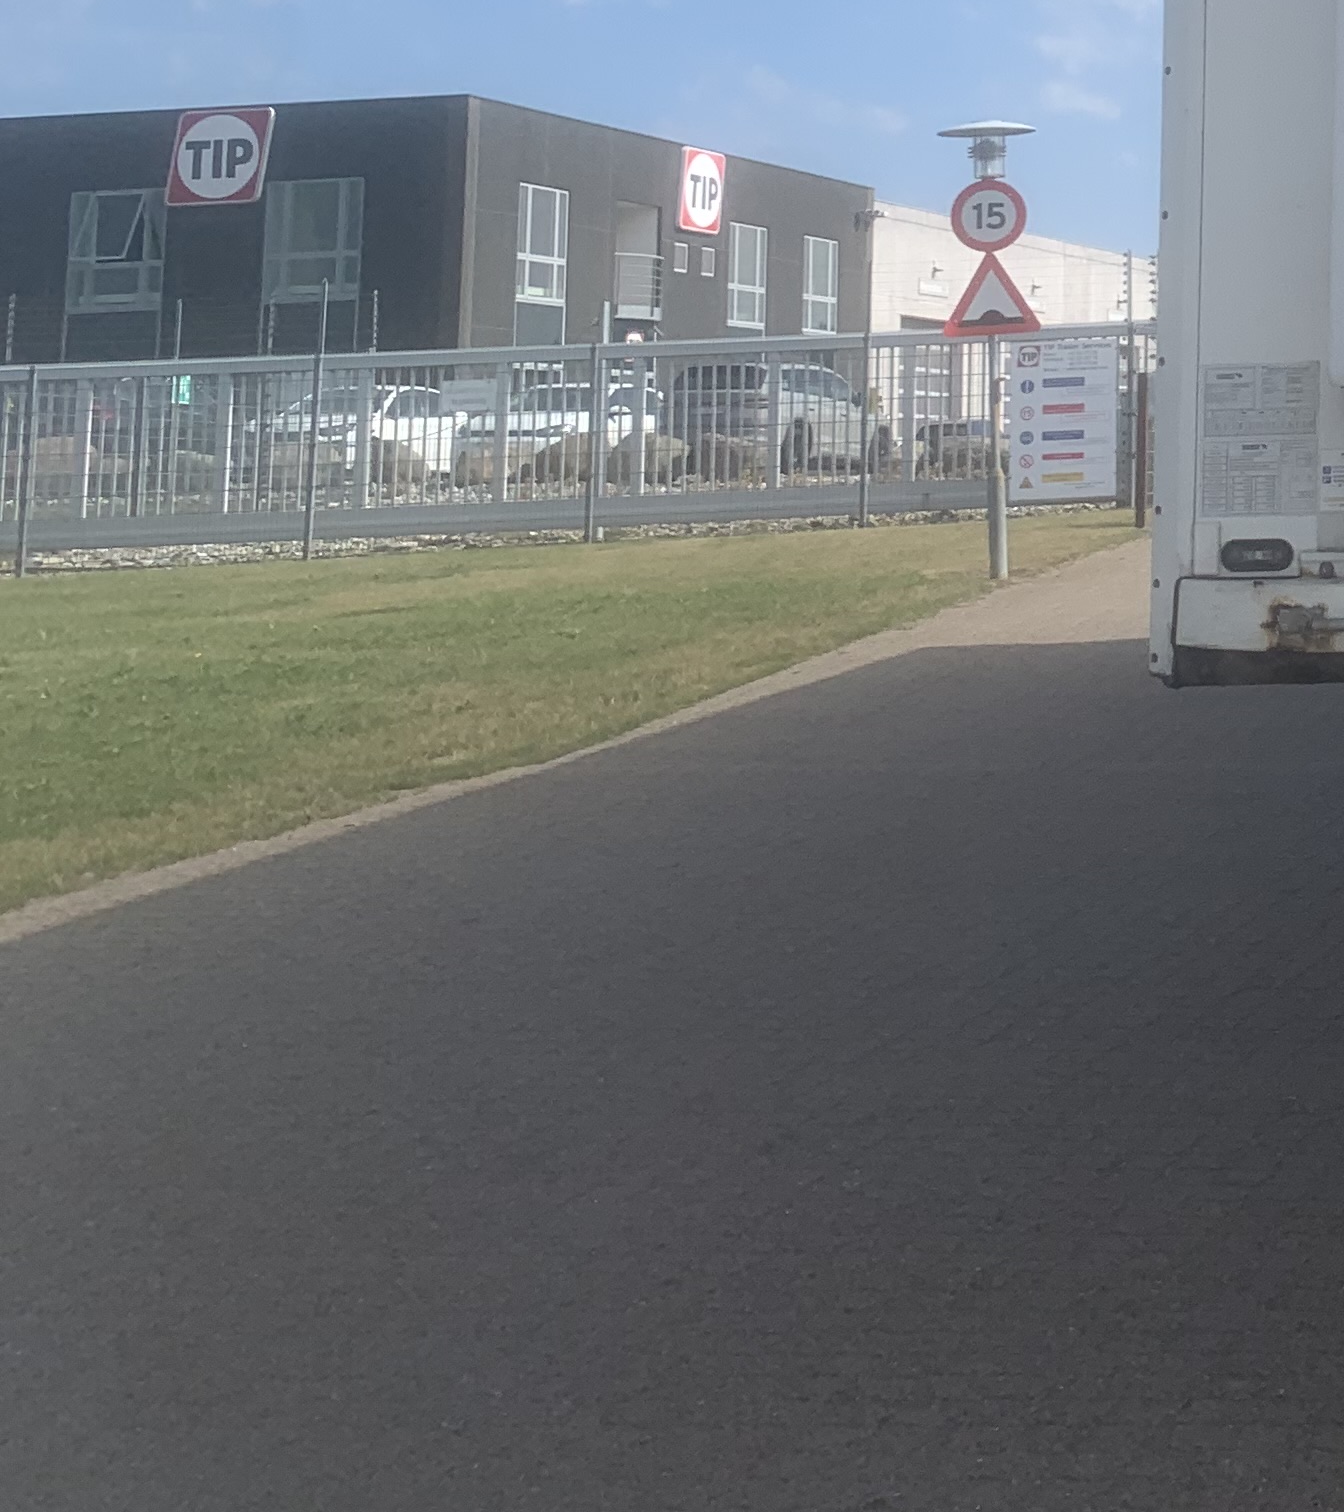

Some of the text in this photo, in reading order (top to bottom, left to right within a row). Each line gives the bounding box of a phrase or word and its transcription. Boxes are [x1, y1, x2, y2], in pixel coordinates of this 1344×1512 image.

[184, 137, 254, 181] TIP
[688, 171, 721, 212] TIP
[971, 202, 1007, 230] 15
[1021, 351, 1038, 362] TIP
